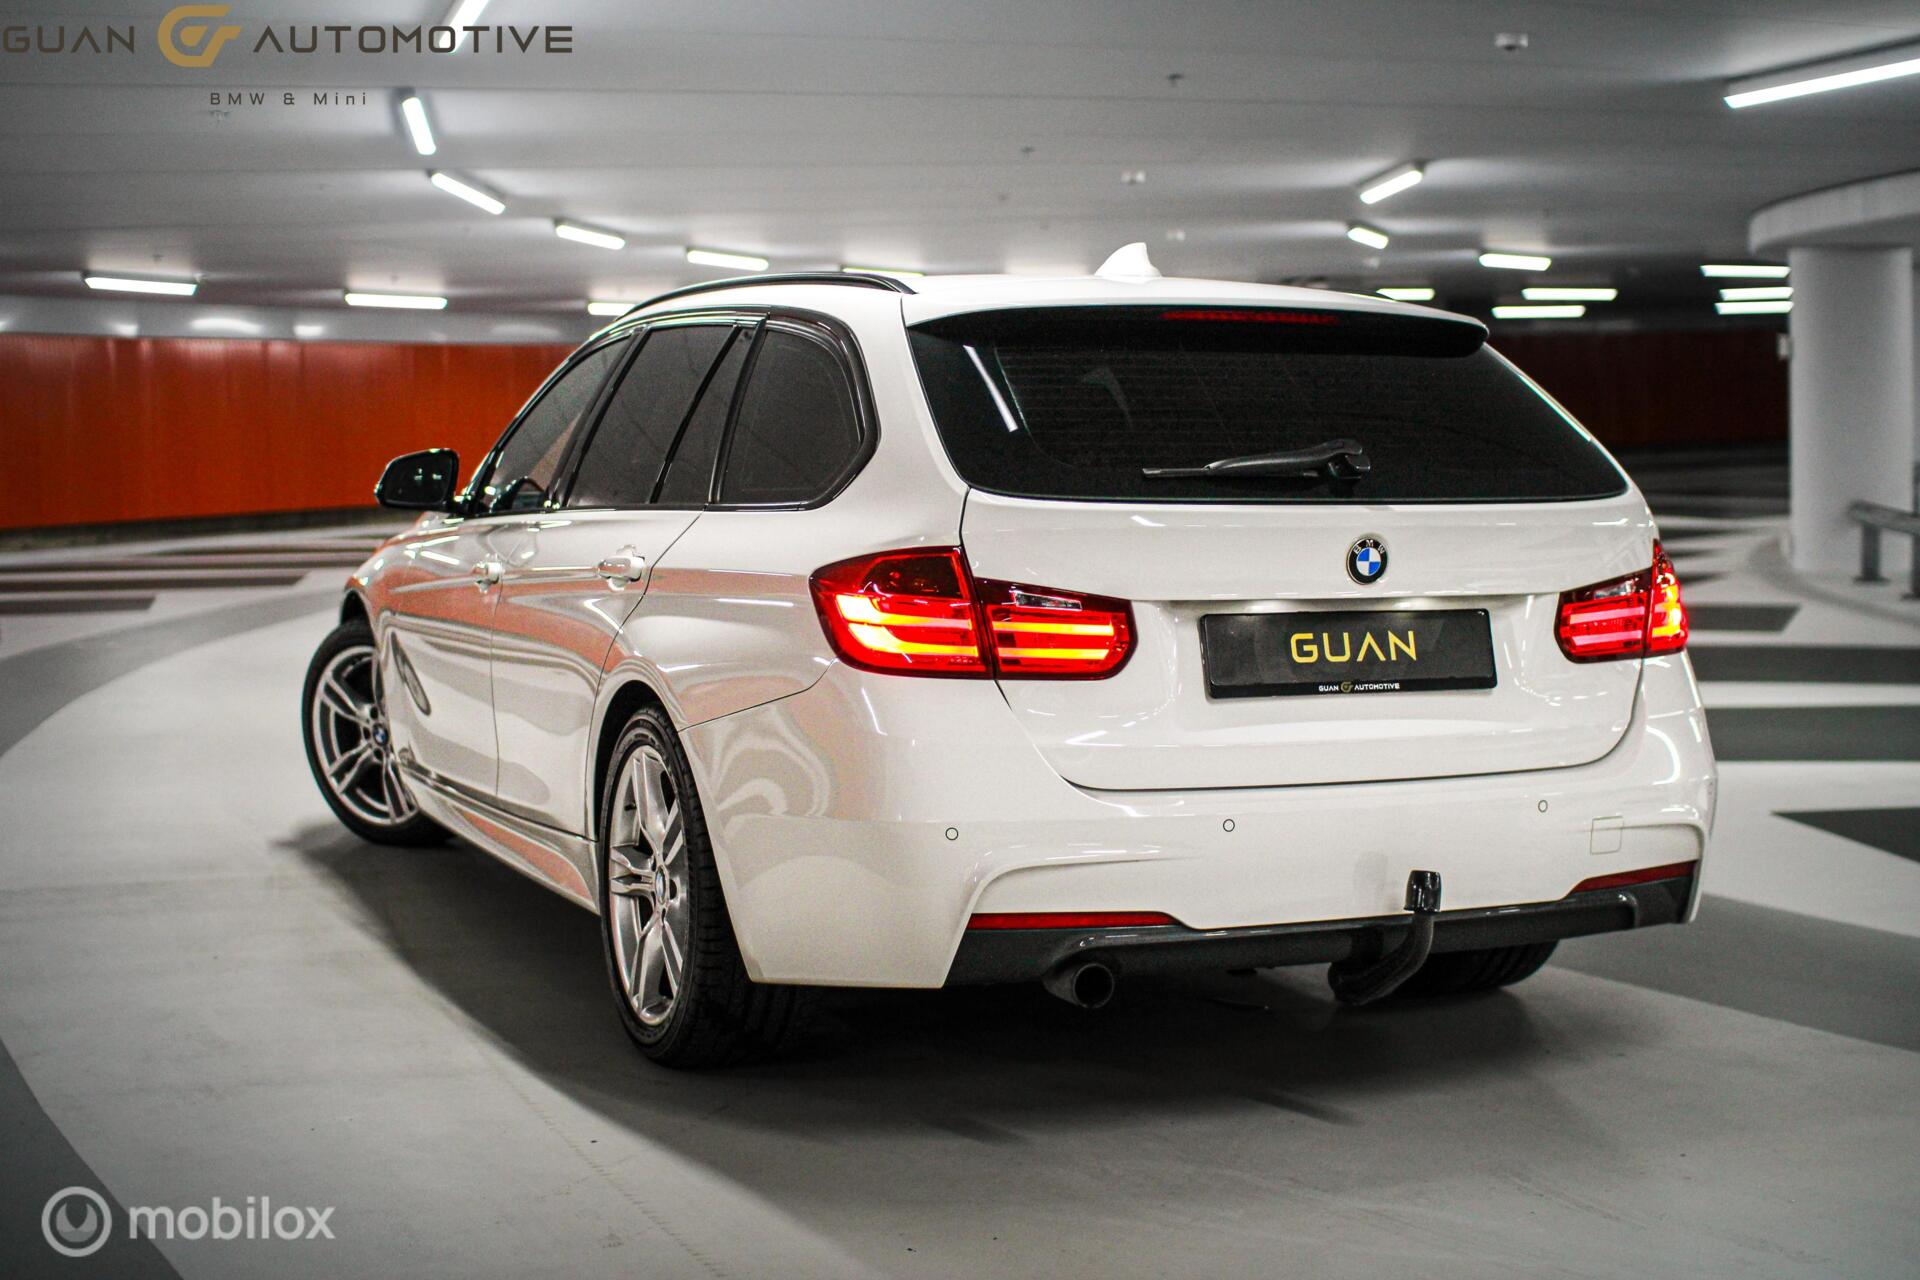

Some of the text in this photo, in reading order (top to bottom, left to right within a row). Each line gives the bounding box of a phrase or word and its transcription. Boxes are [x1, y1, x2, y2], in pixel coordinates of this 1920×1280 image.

[1352, 539, 1385, 555] BMW
[1290, 630, 1417, 663] GUAN
[1318, 682, 1400, 692] GUAN AUTOMOTIVE
